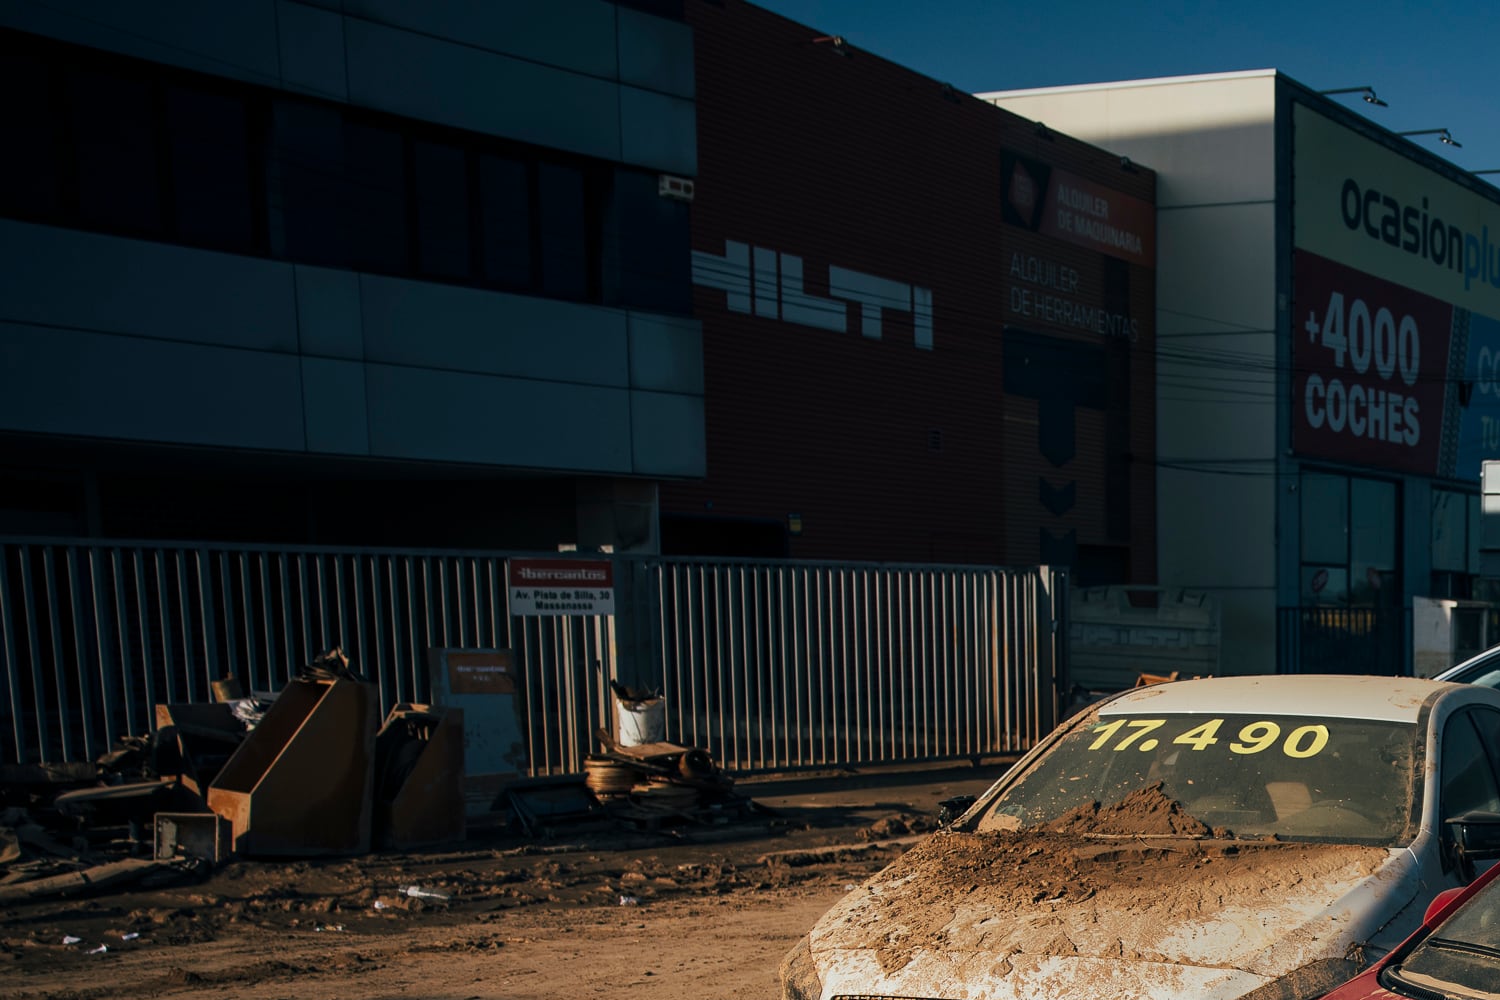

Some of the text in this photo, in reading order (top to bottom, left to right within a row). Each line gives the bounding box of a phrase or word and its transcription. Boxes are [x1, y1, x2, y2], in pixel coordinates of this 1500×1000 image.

[1056, 184, 1109, 219] ALQUILER
[1056, 208, 1143, 254] DE MAQUINARIA
[1010, 252, 1079, 293] ALQUILER
[1010, 286, 1140, 341] DE HERRAMIENTAS
[1305, 291, 1420, 386] +4000
[1304, 373, 1420, 447] COCHES
[1481, 416, 1500, 451] TU
[515, 590, 610, 602] Av. Pista de Silla, 30
[535, 602, 593, 611] Massanassa
[1088, 718, 1330, 760] 17.490
